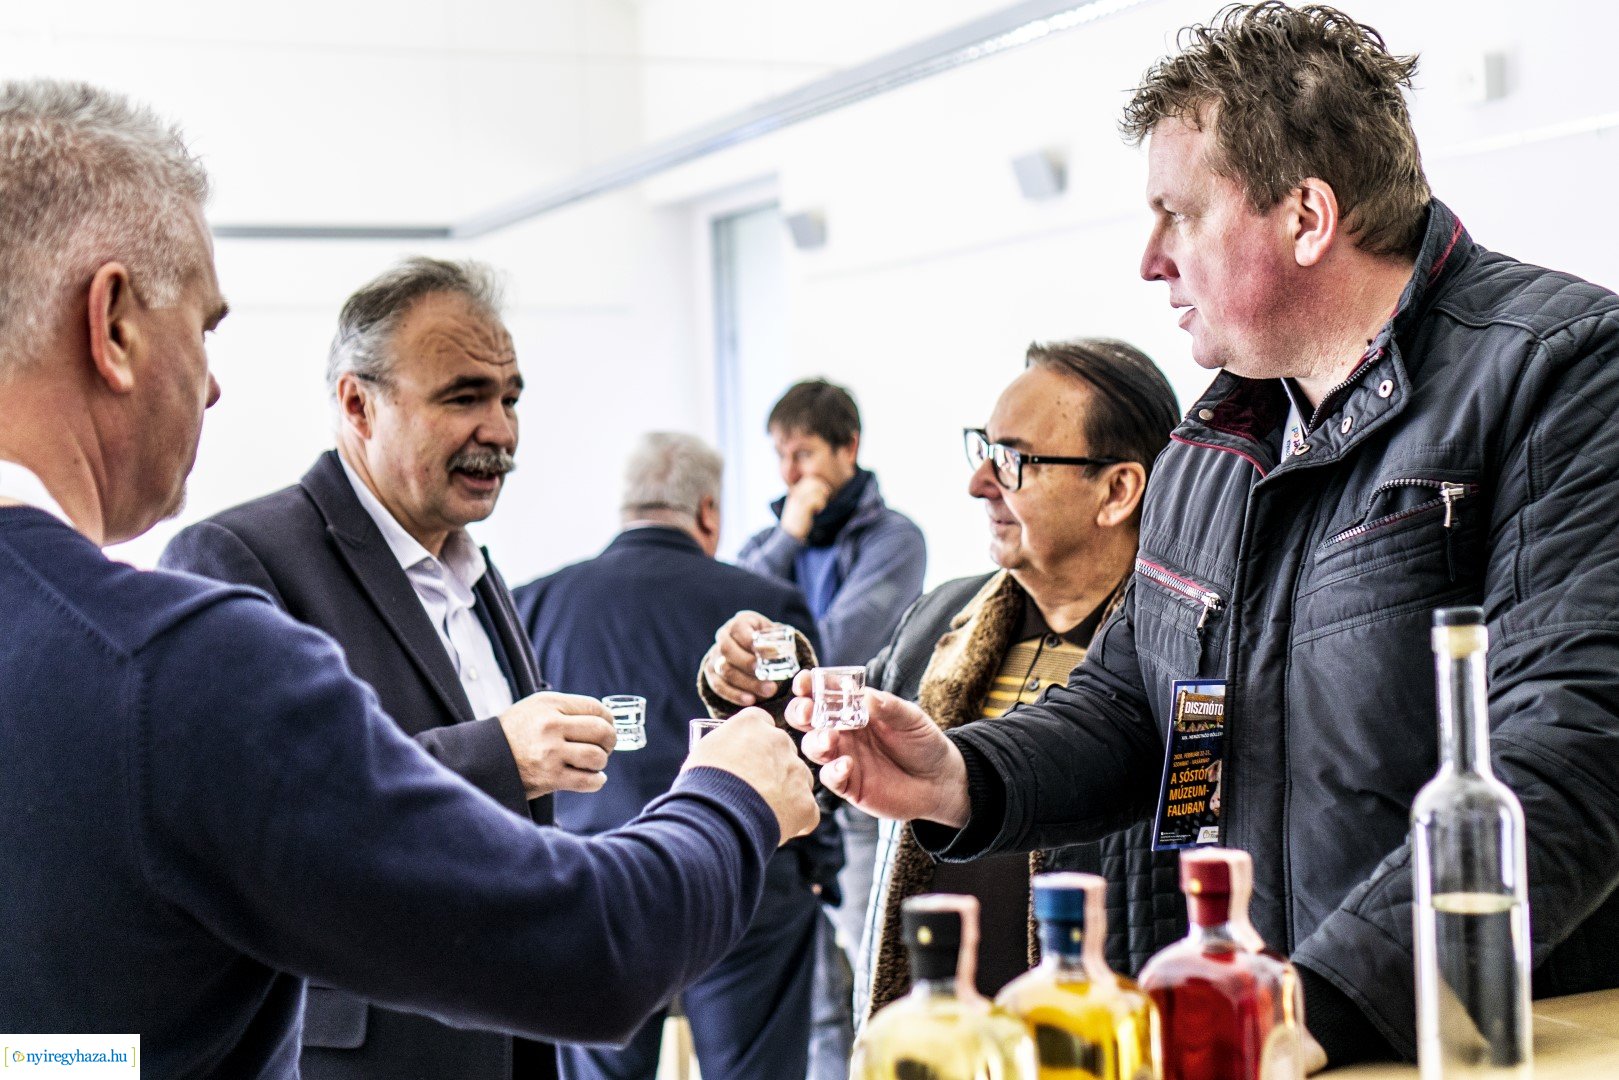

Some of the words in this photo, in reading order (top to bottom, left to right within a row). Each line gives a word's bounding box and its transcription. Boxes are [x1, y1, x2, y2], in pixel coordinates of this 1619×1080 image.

[1185, 700, 1225, 716] DISZNÓTO
[1170, 772, 1177, 785] A
[1169, 784, 1209, 801] MÚZEUM-
[1167, 801, 1205, 817] FALUBAN
